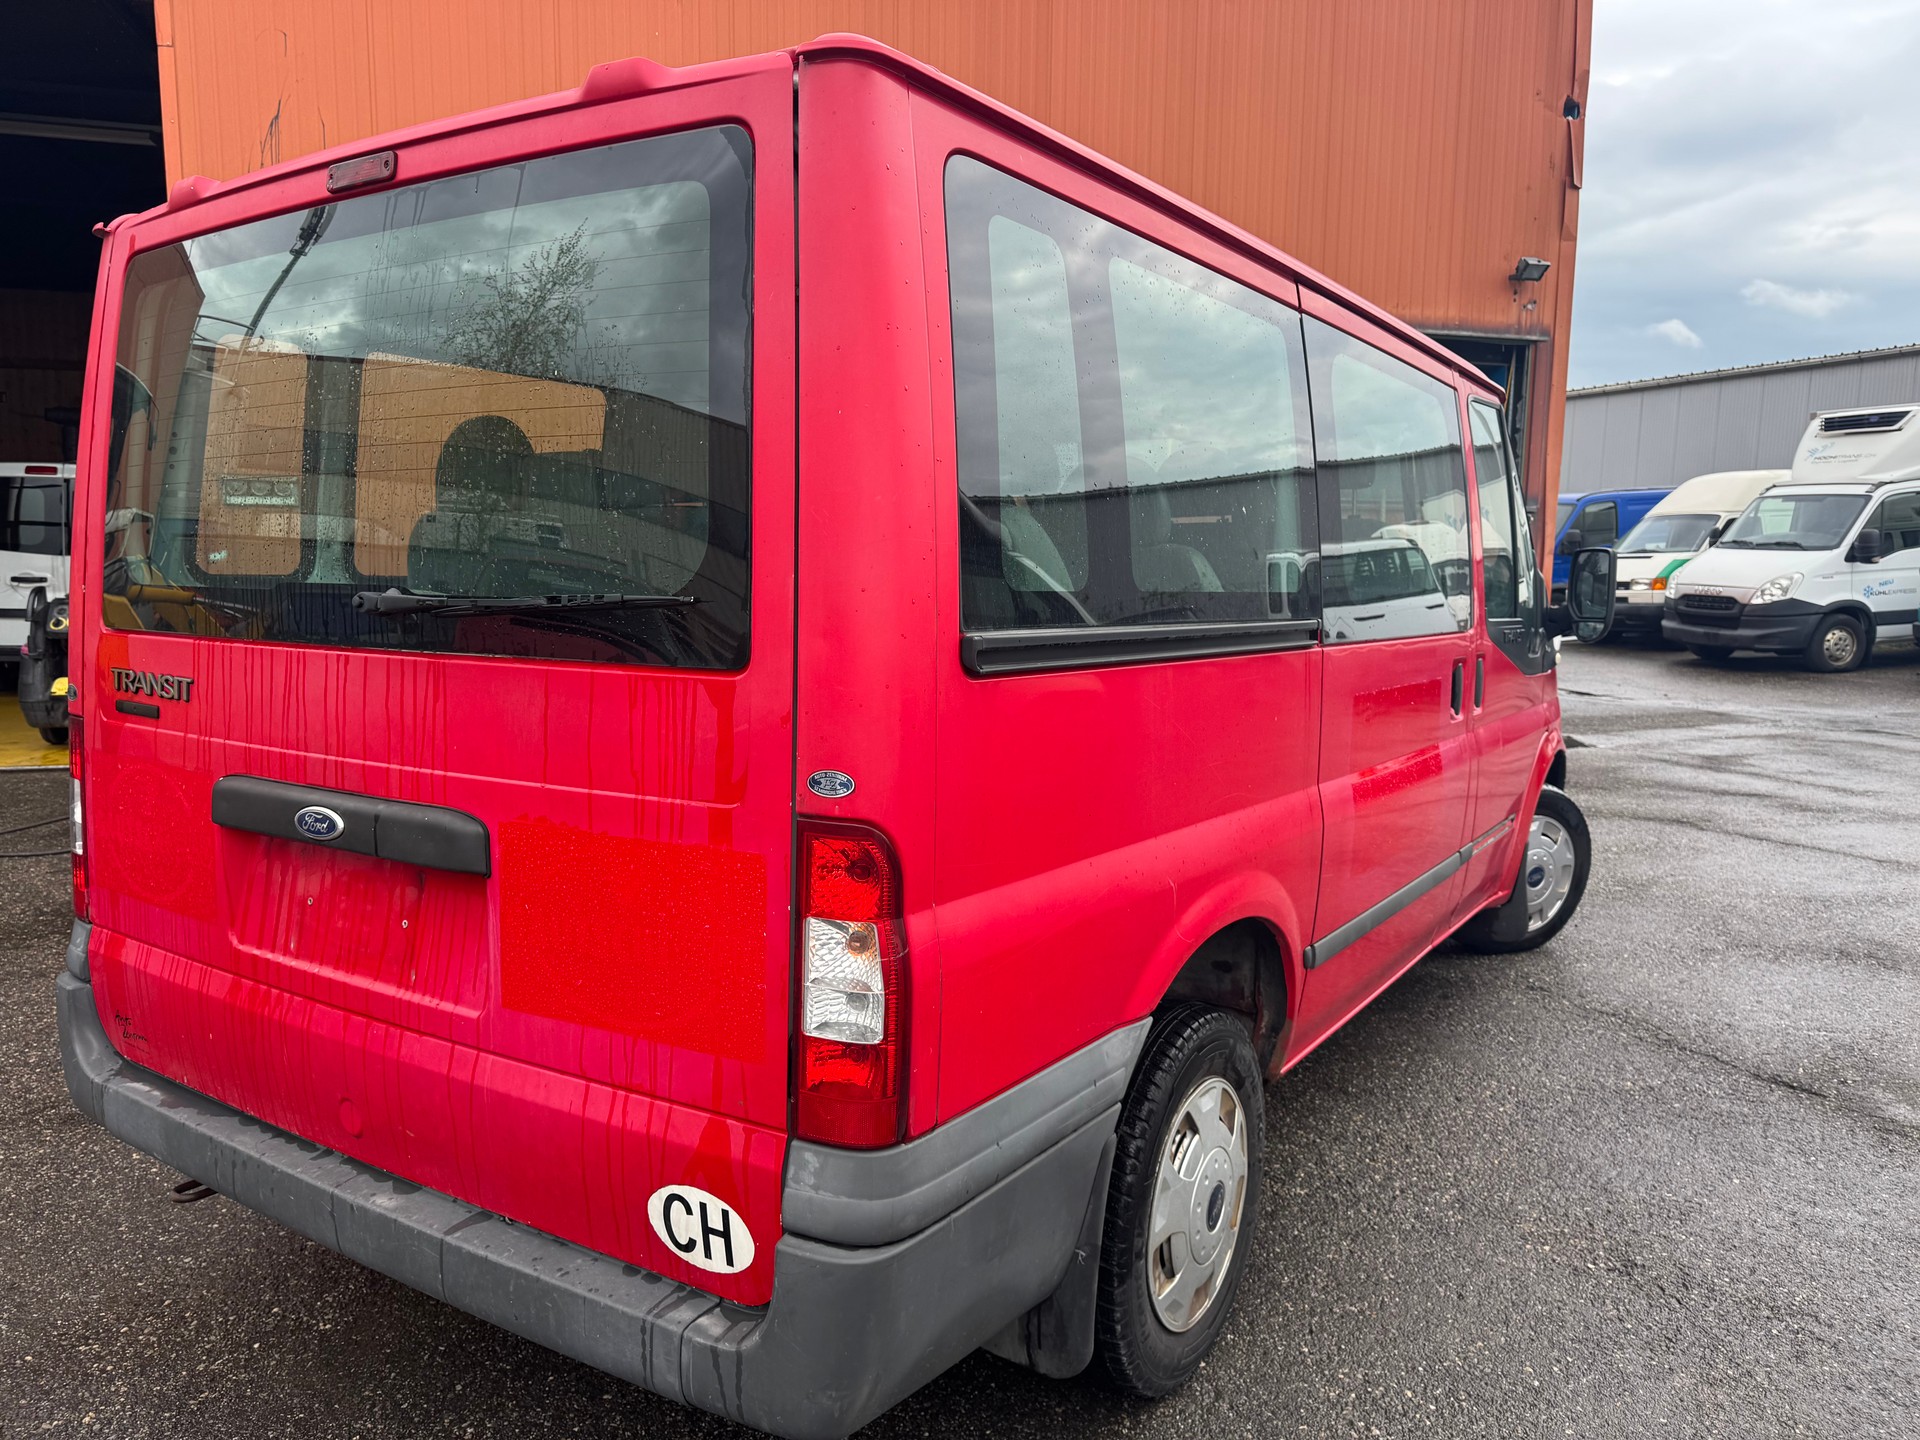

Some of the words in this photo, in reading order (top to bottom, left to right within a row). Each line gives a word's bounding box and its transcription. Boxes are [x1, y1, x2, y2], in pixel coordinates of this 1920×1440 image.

[1694, 585, 1723, 595] IVECO
[1879, 579, 1894, 587] NEU
[111, 667, 194, 702] TRANSIT
[302, 812, 330, 833] Ford
[662, 1192, 735, 1268] CH
